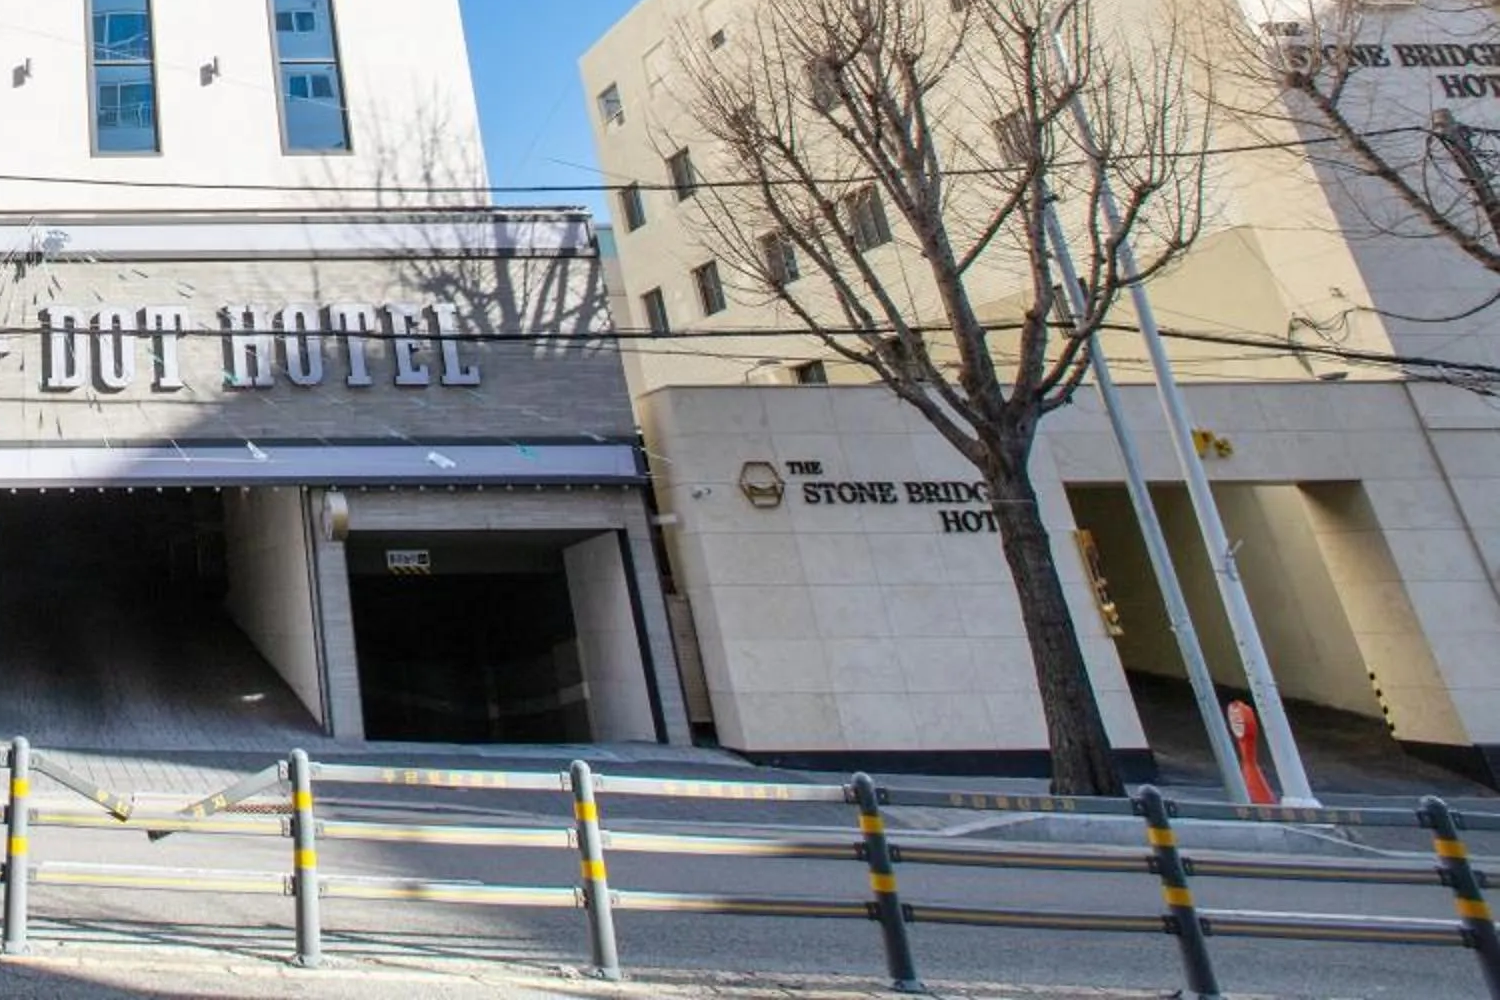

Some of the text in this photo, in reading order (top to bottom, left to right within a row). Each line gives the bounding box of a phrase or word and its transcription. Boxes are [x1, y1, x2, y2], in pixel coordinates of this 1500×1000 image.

[1289, 43, 1391, 68] SONE
[1437, 74, 1500, 99] HOT
[46, 303, 189, 388] DOT
[227, 302, 480, 387] HOTEL
[786, 461, 823, 475] THE
[804, 481, 989, 504] STONE BRIDG
[939, 510, 999, 533] HOT
